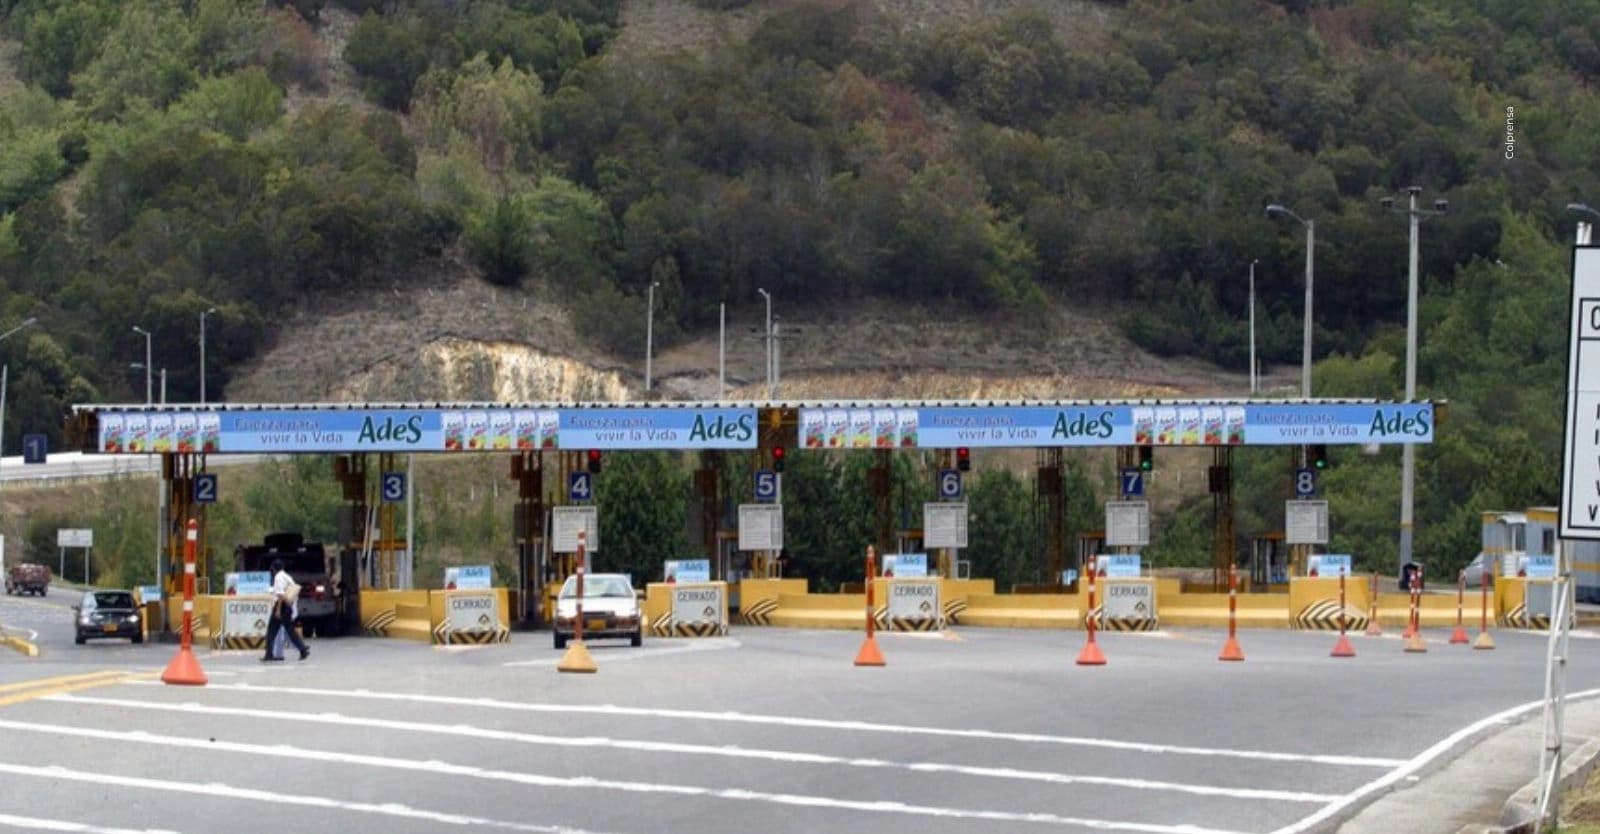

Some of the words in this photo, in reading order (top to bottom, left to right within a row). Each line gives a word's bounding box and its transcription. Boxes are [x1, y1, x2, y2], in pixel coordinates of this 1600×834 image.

[358, 415, 422, 444] AdeS
[689, 414, 753, 442] AdeS
[957, 427, 986, 439] vivir
[991, 427, 1003, 439] la
[1008, 427, 1038, 439] Vida
[1051, 411, 1113, 439] AdeS
[1279, 425, 1309, 437] vivir
[1312, 424, 1325, 437] la
[1329, 424, 1360, 437] Vida
[1368, 409, 1430, 437] AdeS
[261, 432, 291, 444] vivir
[295, 432, 307, 444] la
[312, 431, 343, 444] Vida
[595, 430, 625, 441] vivir
[629, 429, 642, 441] la
[647, 429, 677, 441] Vida
[28, 440, 39, 460] 1
[198, 477, 213, 499] 2
[386, 476, 401, 499] 3
[572, 475, 589, 497] 4
[758, 474, 774, 495] 5
[943, 473, 958, 495] 6
[1125, 471, 1139, 492] 7
[1297, 471, 1313, 493] 8
[678, 591, 716, 602] CERRADO
[895, 586, 933, 596] CERRADO
[1111, 586, 1148, 596] CERRADO
[229, 603, 268, 615] CERRADO
[453, 599, 492, 609] CERRADO
